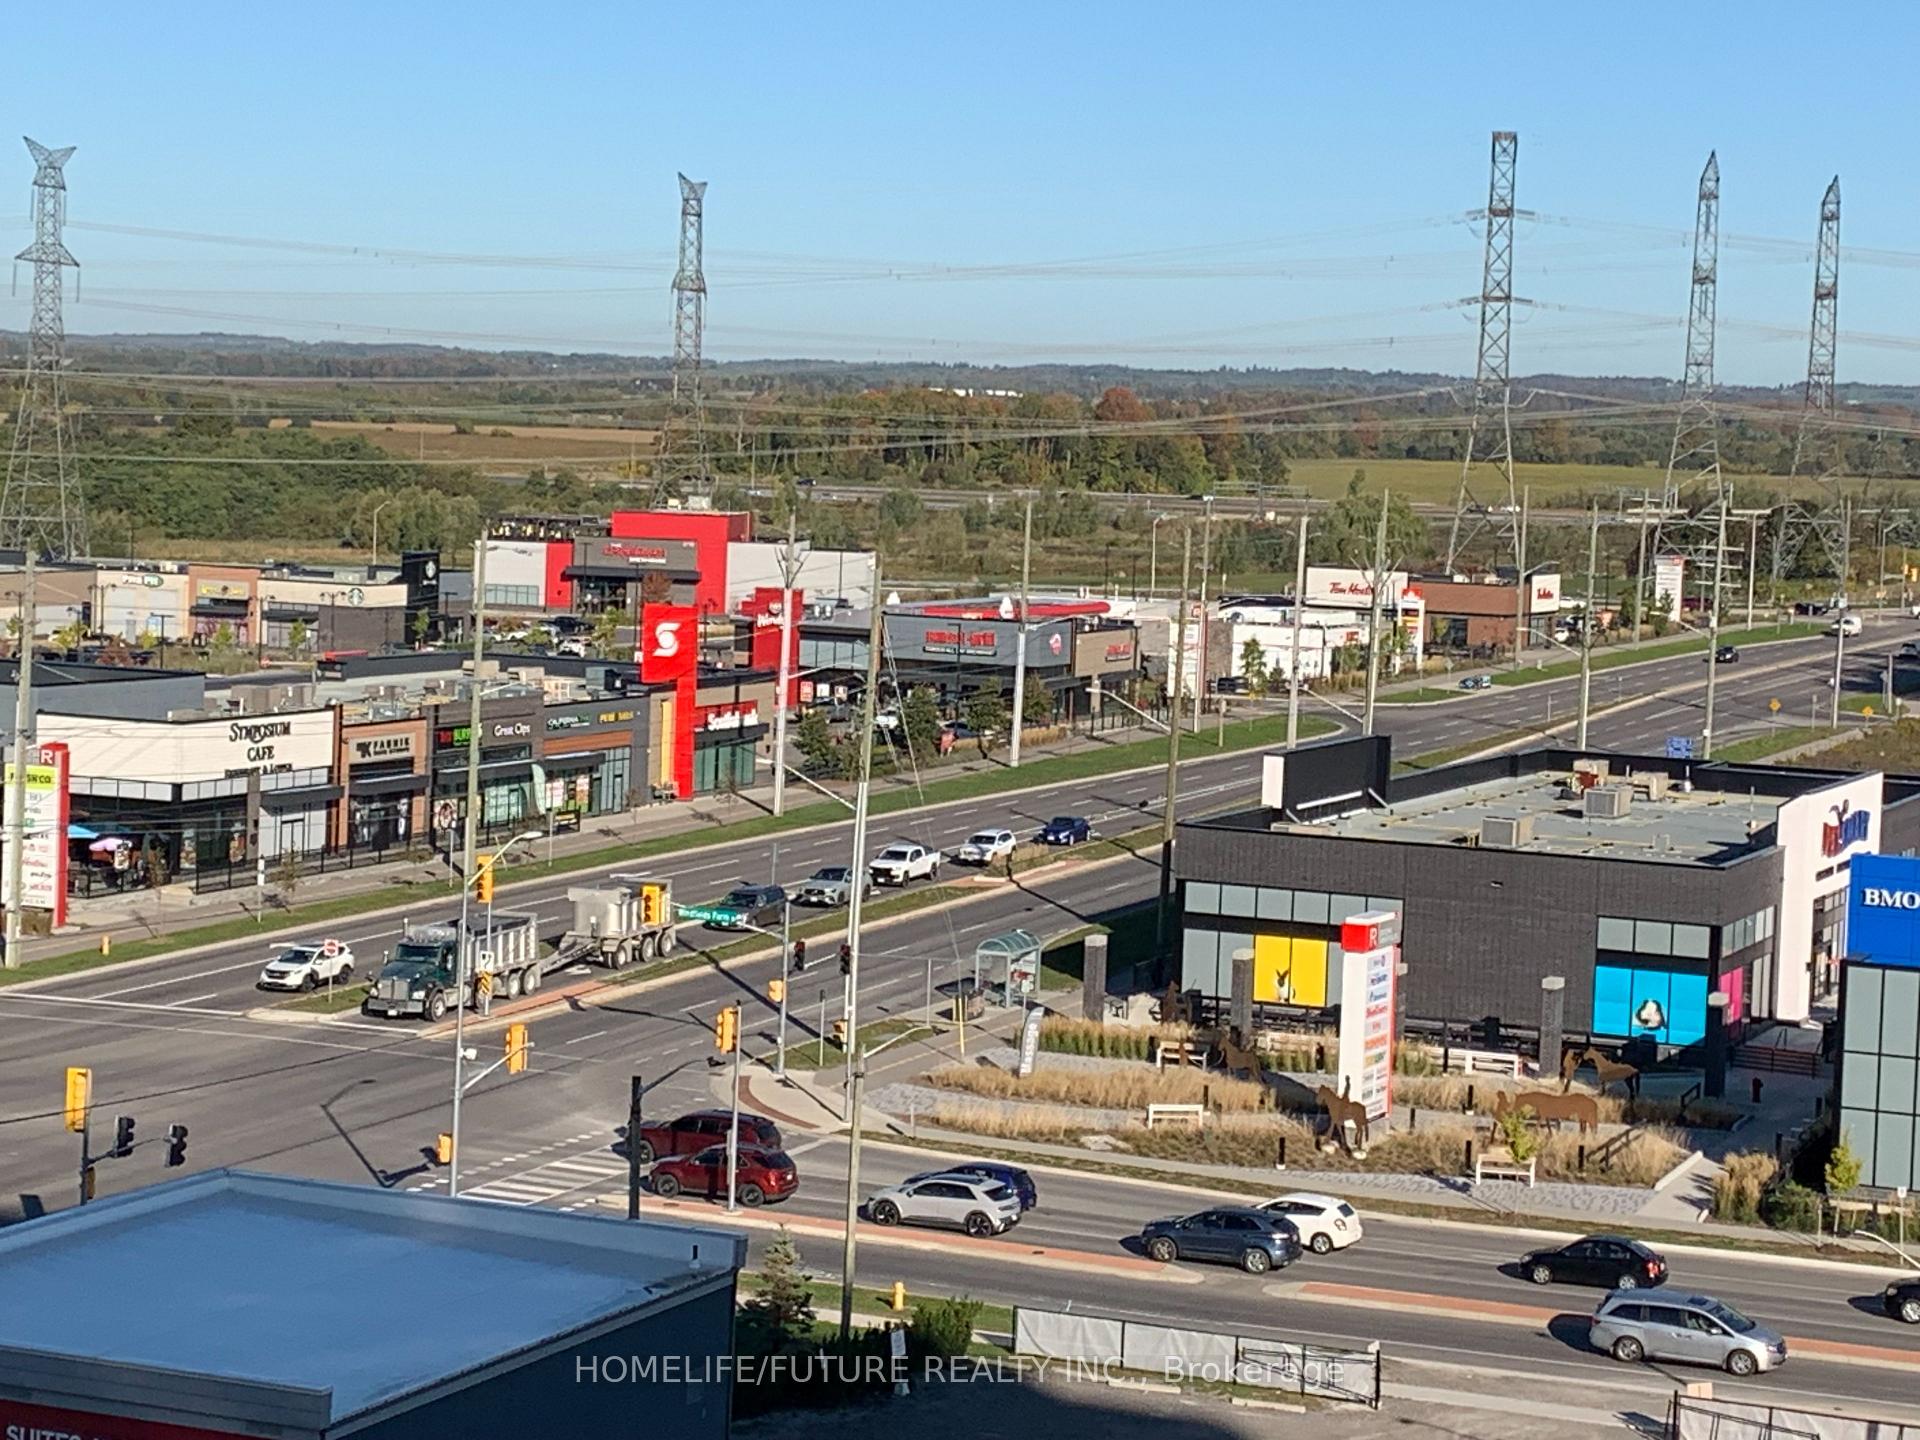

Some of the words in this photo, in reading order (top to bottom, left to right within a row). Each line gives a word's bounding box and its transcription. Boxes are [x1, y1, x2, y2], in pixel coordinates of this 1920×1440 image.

[229, 722, 291, 743] SYMPOSIUM
[41, 750, 53, 764] R
[247, 746, 274, 761] CAFE
[1864, 888, 1920, 909] BMO
